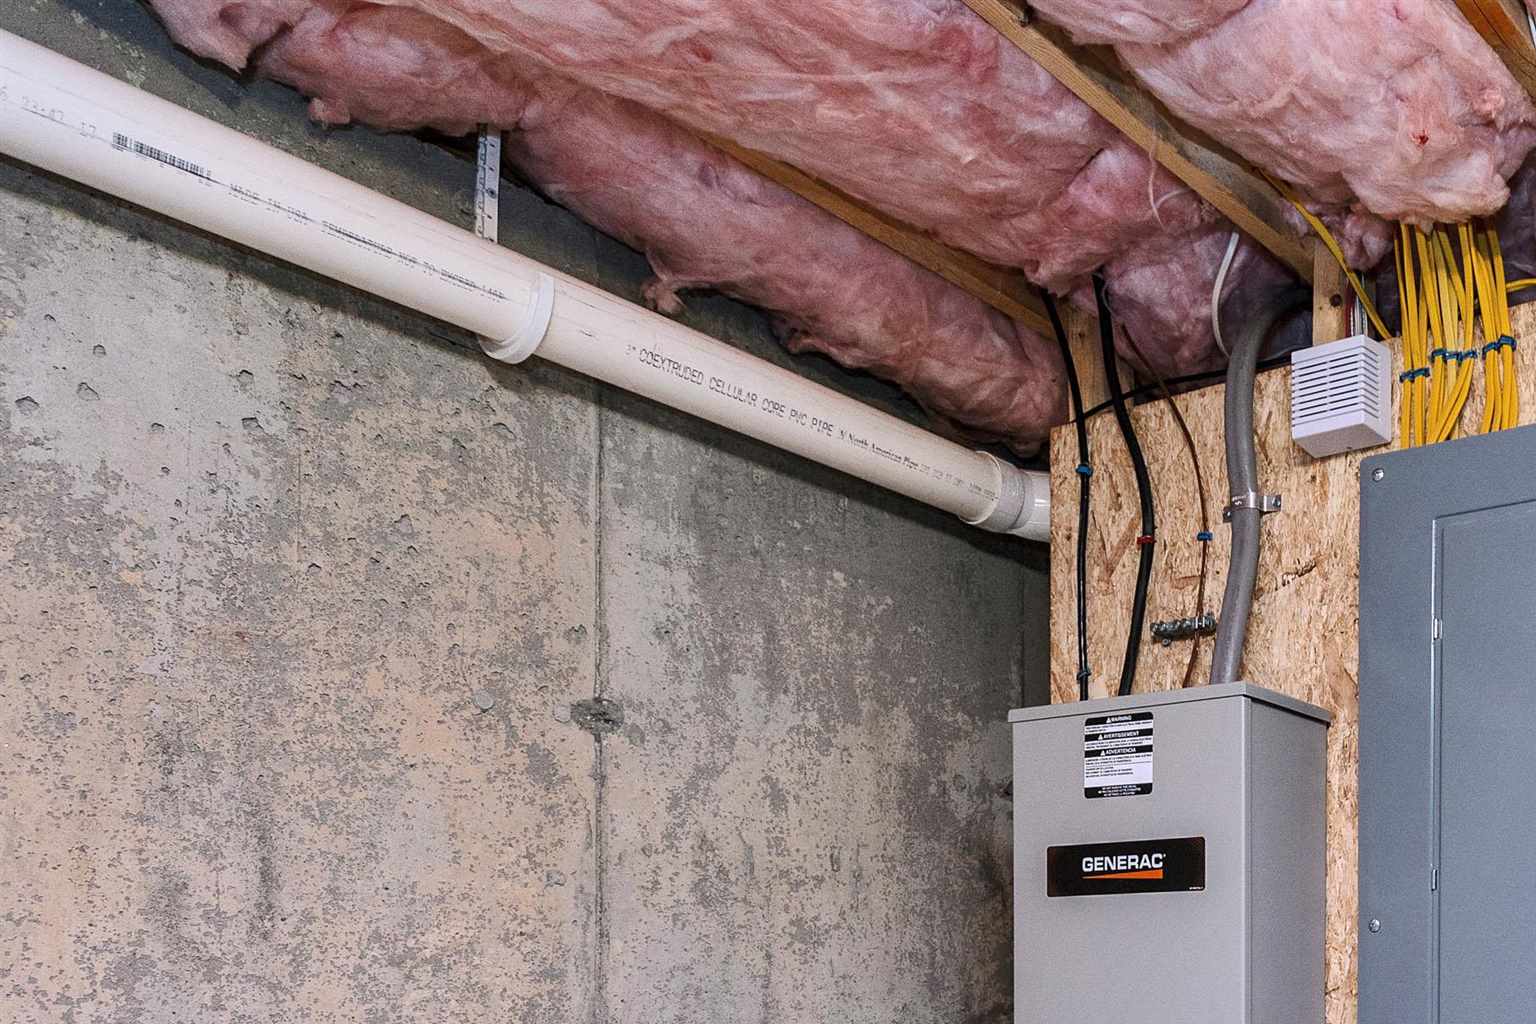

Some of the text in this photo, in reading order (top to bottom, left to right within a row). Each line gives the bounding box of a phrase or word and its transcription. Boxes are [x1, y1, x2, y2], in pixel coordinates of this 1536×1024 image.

[639, 347, 704, 386] COEXTRUDED
[709, 376, 758, 408] CELLULAR
[761, 397, 787, 418] CORE
[1082, 852, 1164, 872] GENERAC
